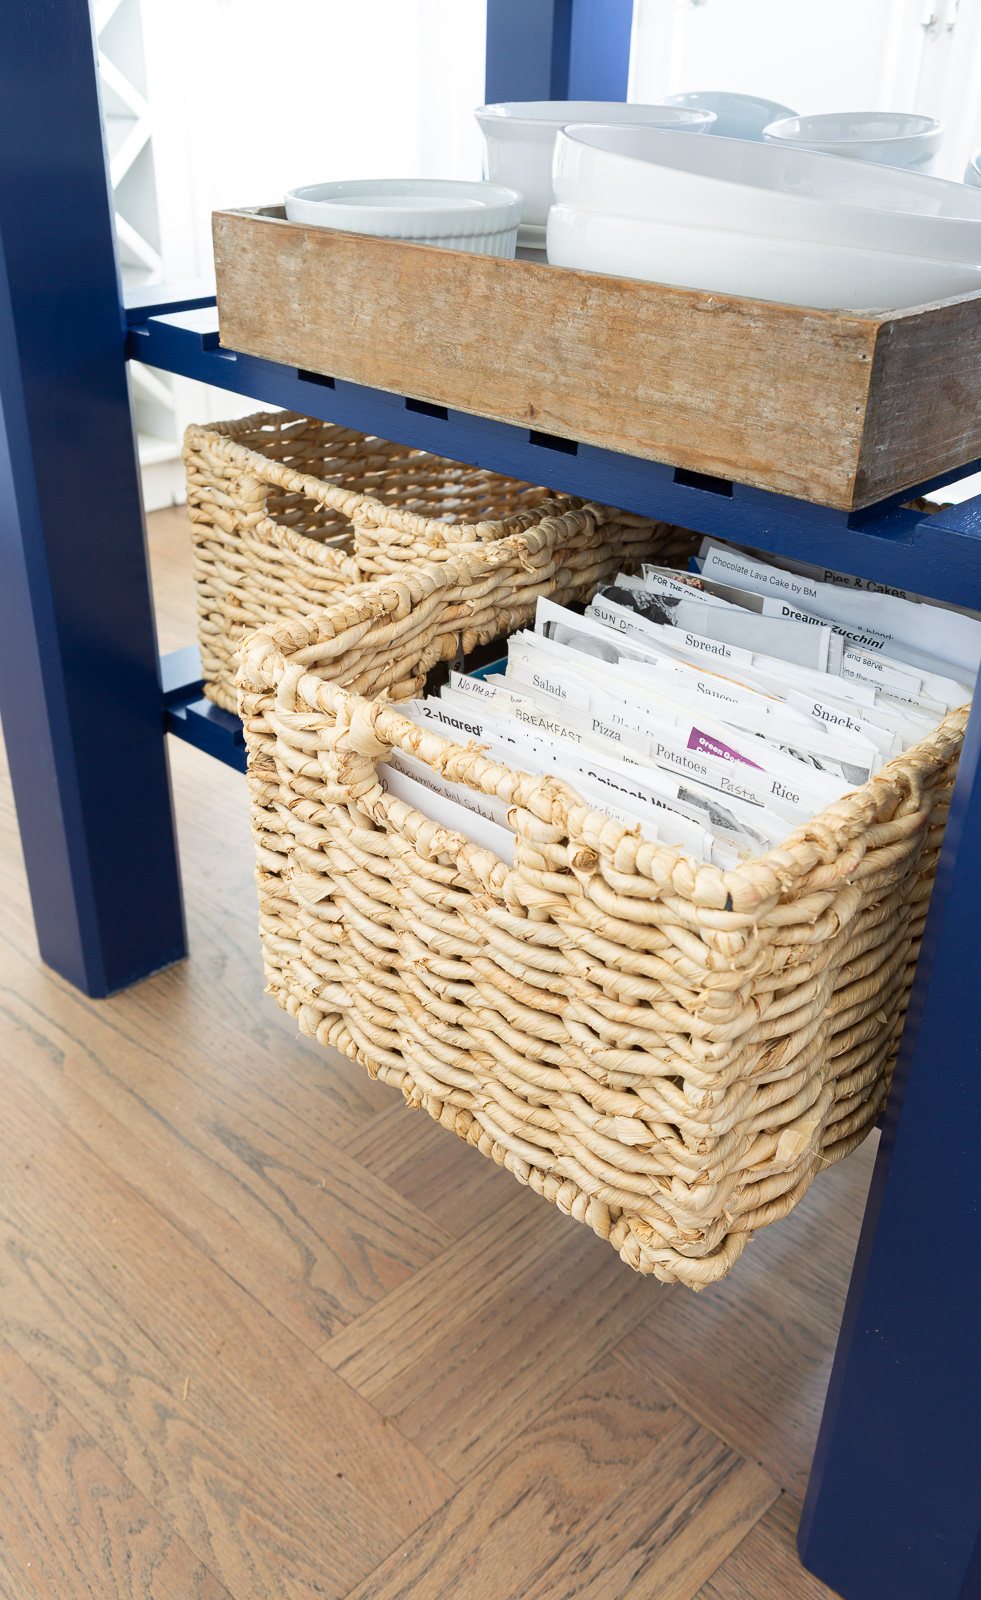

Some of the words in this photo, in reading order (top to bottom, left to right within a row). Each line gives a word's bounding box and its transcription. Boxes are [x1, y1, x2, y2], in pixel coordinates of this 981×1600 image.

[652, 574, 668, 588] FOR
[669, 581, 683, 593] THE
[711, 555, 749, 576] Chocolate
[750, 568, 768, 583] Lava
[769, 575, 790, 591] Cake
[791, 582, 802, 594] by
[803, 587, 817, 599] BM
[824, 570, 850, 585] Pies
[853, 577, 863, 588] &
[866, 580, 907, 600] Cakes
[594, 608, 616, 625] SUN
[685, 633, 732, 658] Spreads
[831, 624, 886, 650] Zucchini
[457, 677, 470, 691] No
[532, 675, 567, 699] Salads
[422, 706, 484, 738] 2-Ingred
[515, 708, 583, 744] BREAKFAST
[591, 718, 622, 742] Pizza
[811, 703, 862, 733] Snacks
[655, 743, 708, 775] Potatoes
[698, 737, 724, 756] Green
[720, 777, 760, 805] Pasta
[770, 780, 800, 804] Rice
